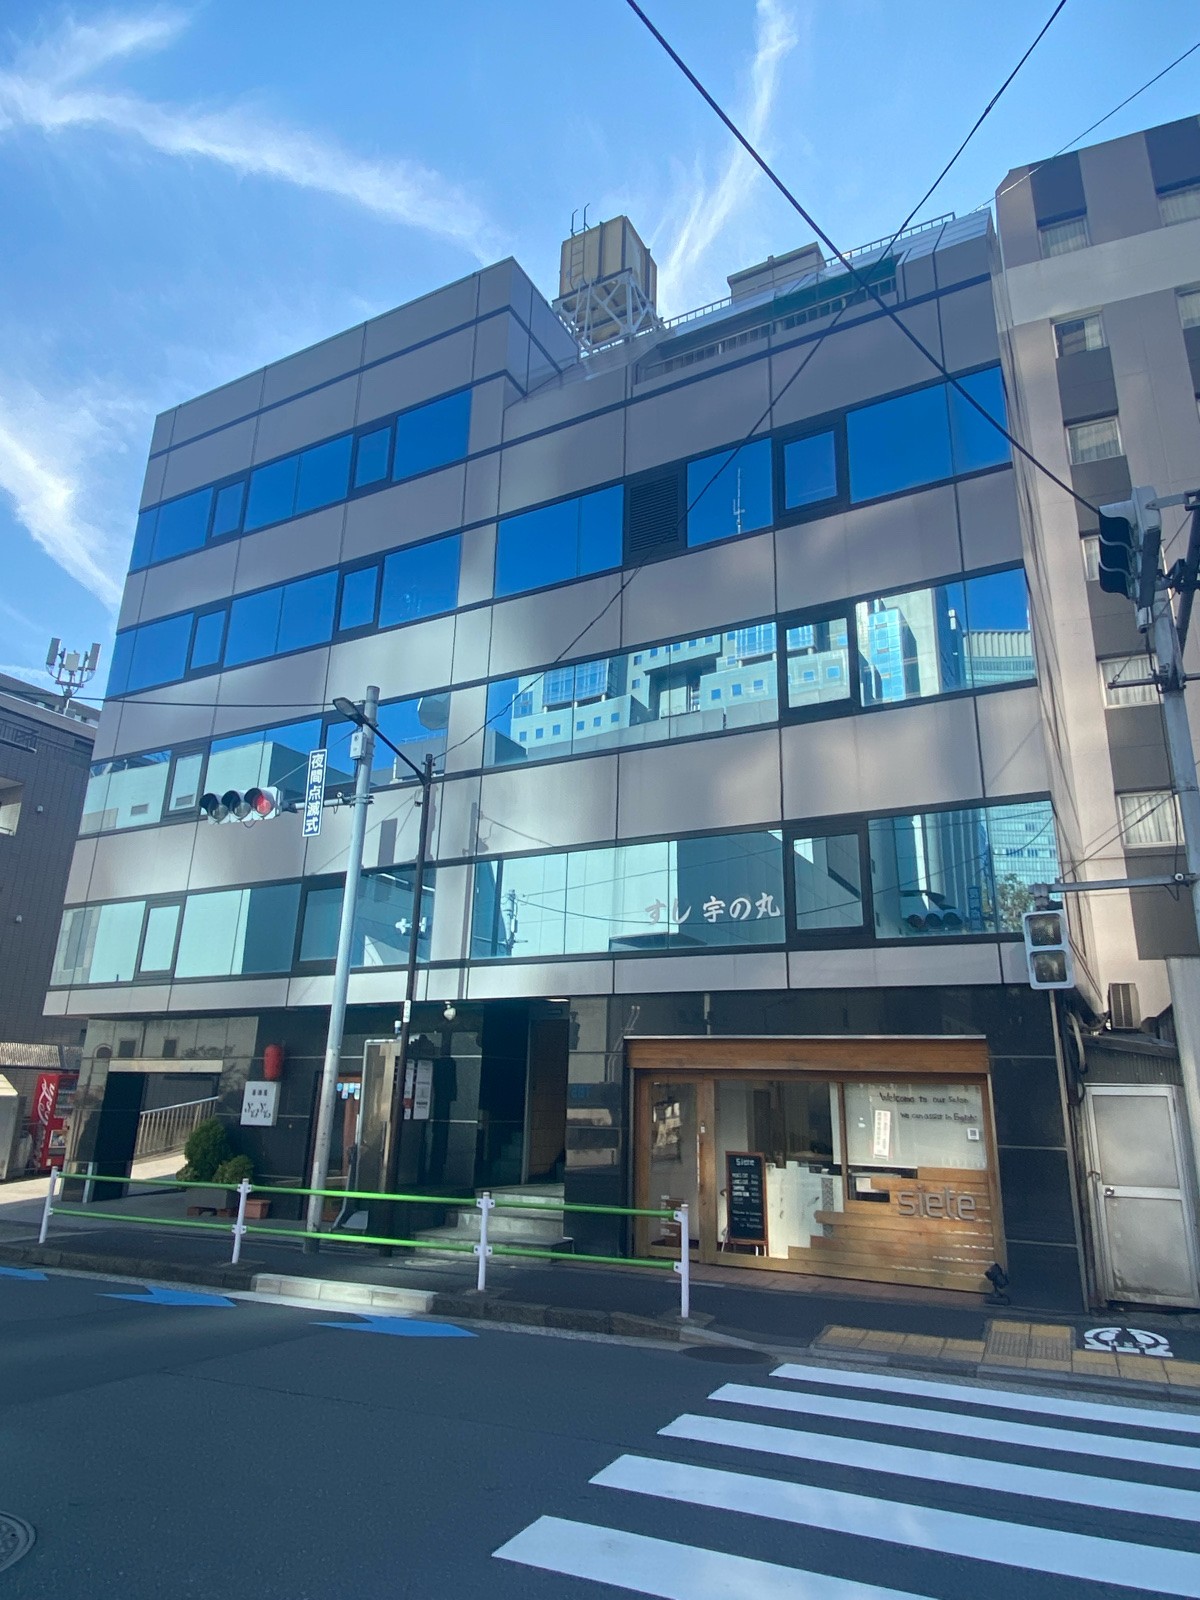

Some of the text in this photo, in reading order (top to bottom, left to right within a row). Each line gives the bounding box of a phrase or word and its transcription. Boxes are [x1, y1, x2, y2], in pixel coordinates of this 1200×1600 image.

[305, 753, 325, 833] 夜間点滅式
[645, 898, 692, 925] すし
[897, 1183, 976, 1221] siete
